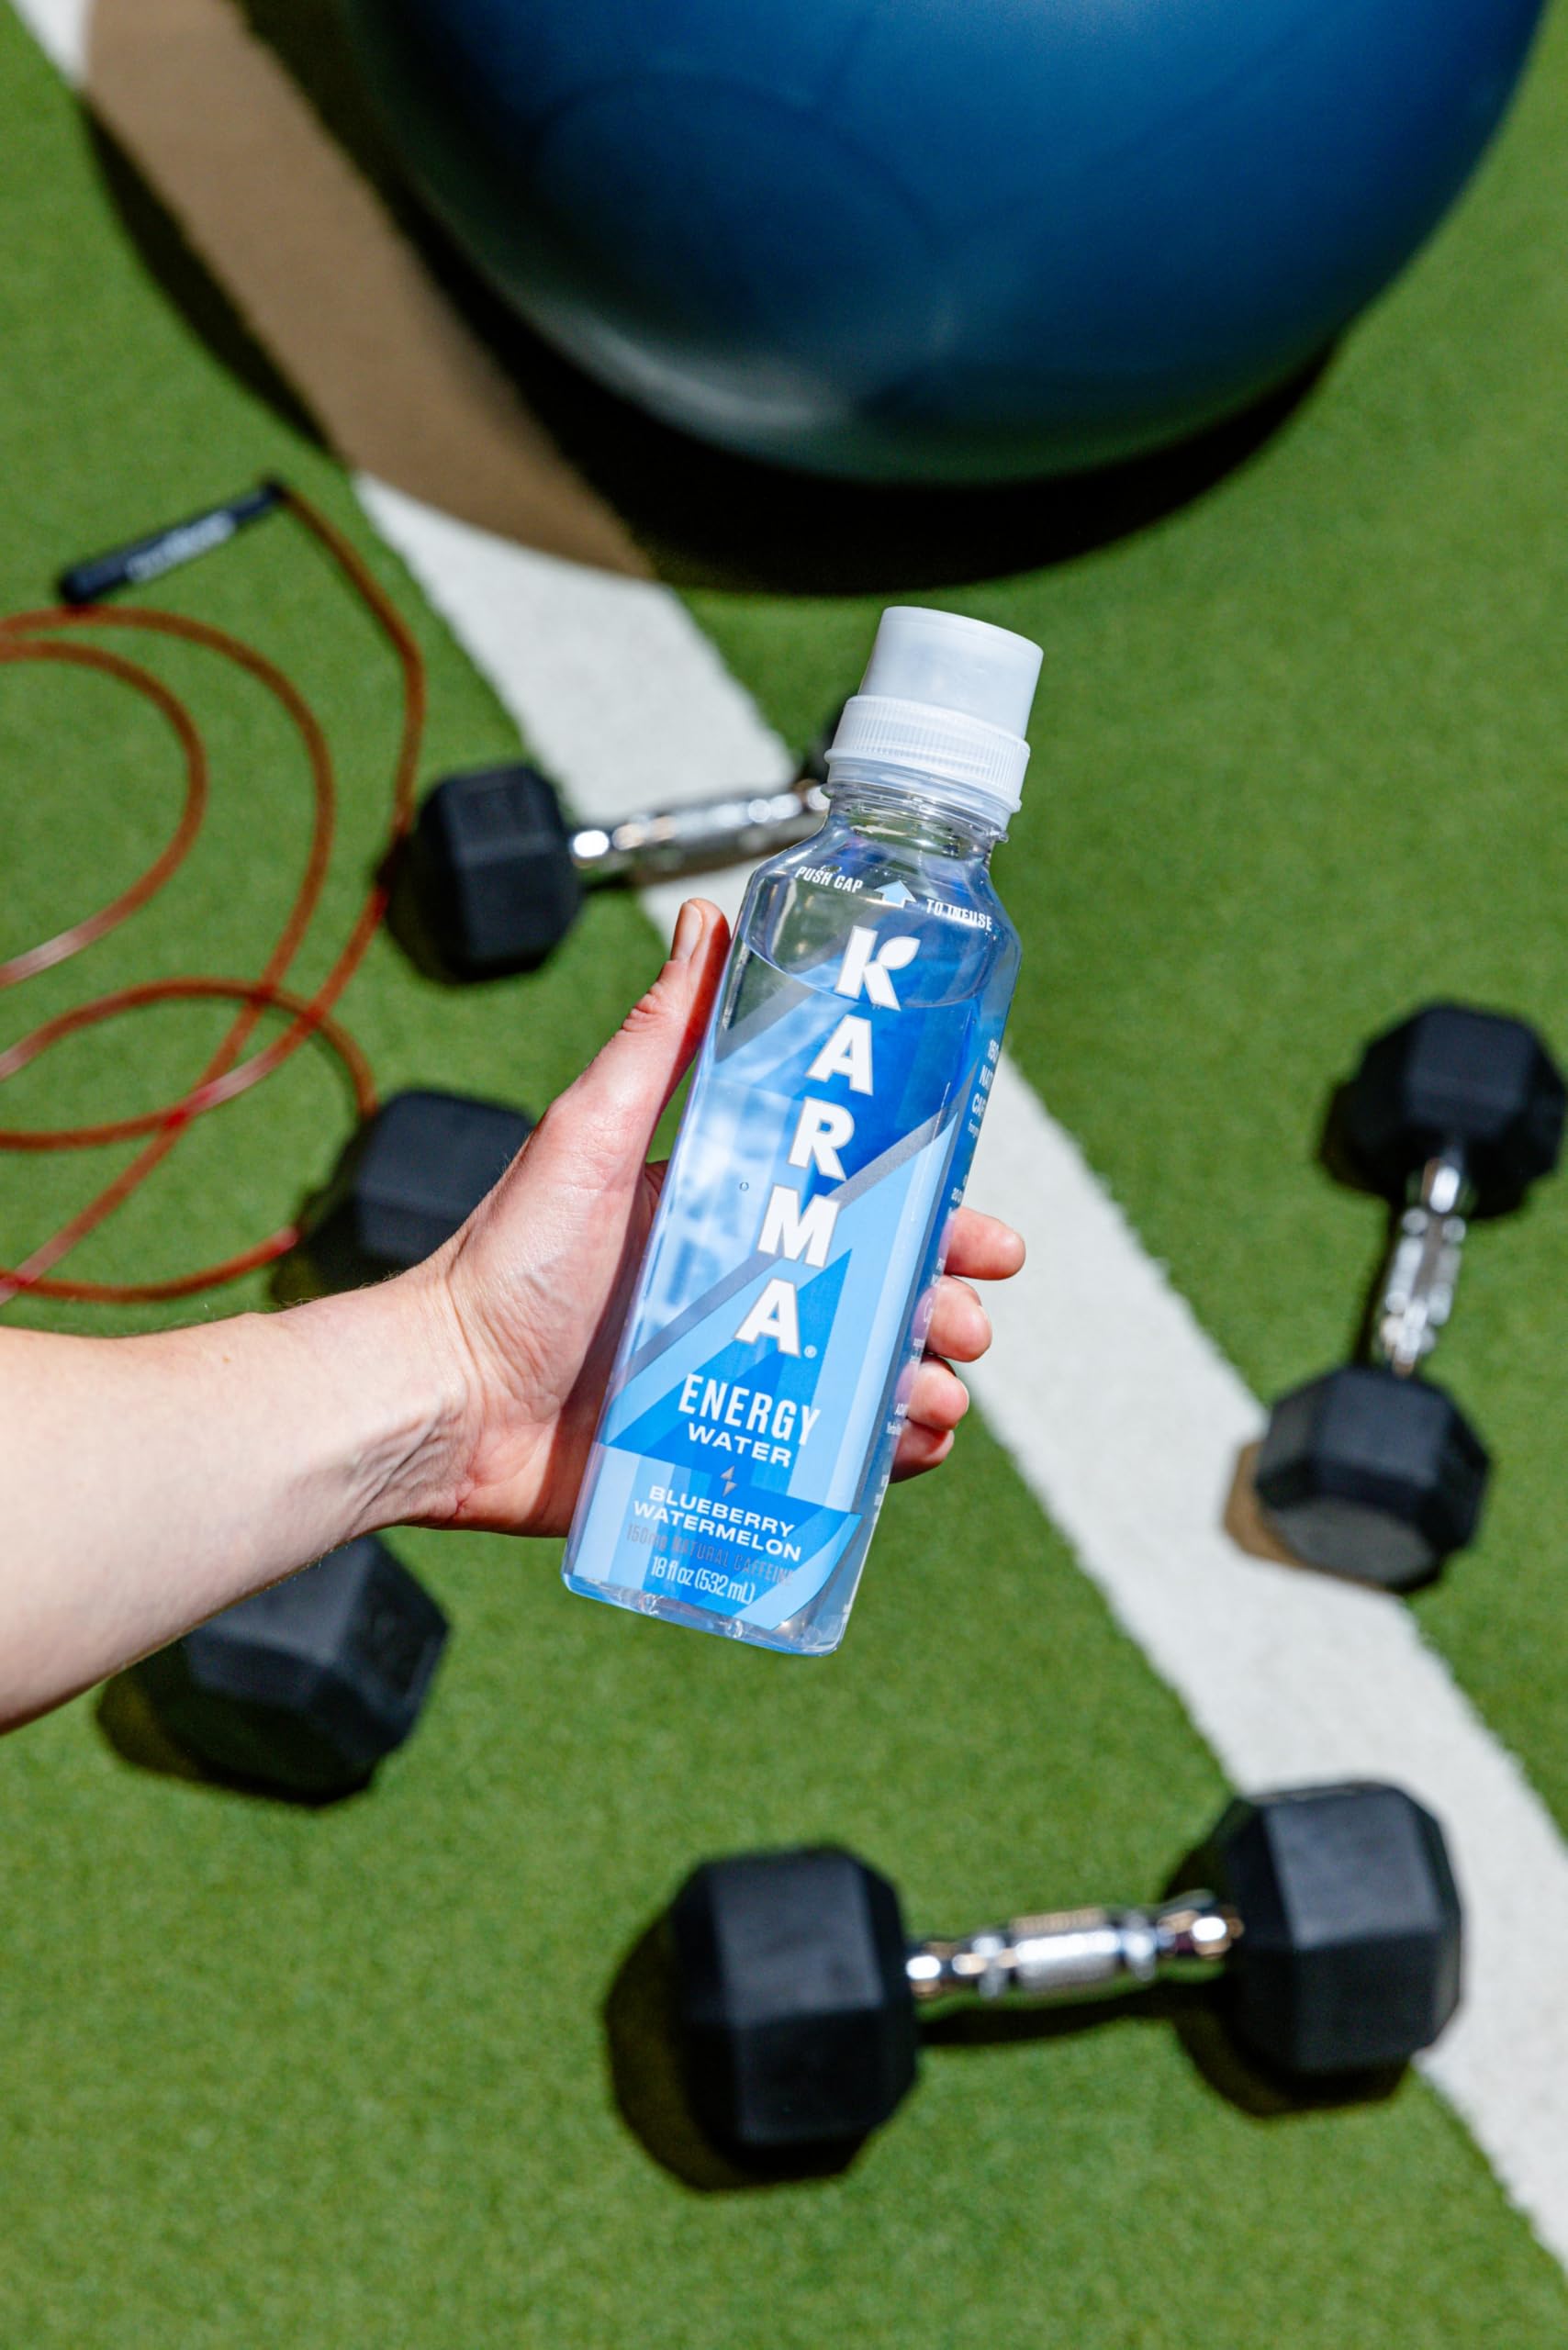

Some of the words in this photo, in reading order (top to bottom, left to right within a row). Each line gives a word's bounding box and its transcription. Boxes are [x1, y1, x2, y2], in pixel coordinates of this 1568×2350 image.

[795, 866, 833, 887] PUSH
[834, 874, 864, 893] CAP
[926, 898, 944, 916] TO
[678, 1373, 822, 1447] ENERGY
[688, 1422, 792, 1468] WATER
[633, 1500, 802, 1562] WATERMELON
[648, 1485, 795, 1538] BLUEBERRY
[651, 1555, 667, 1578] 18
[666, 1559, 680, 1582] fl
[678, 1567, 693, 1587] oz
[694, 1567, 730, 1597] (532
[726, 1579, 756, 1606] mL)
[671, 1534, 731, 1568] NATURAL
[734, 1553, 795, 1585] CAFFEINE
